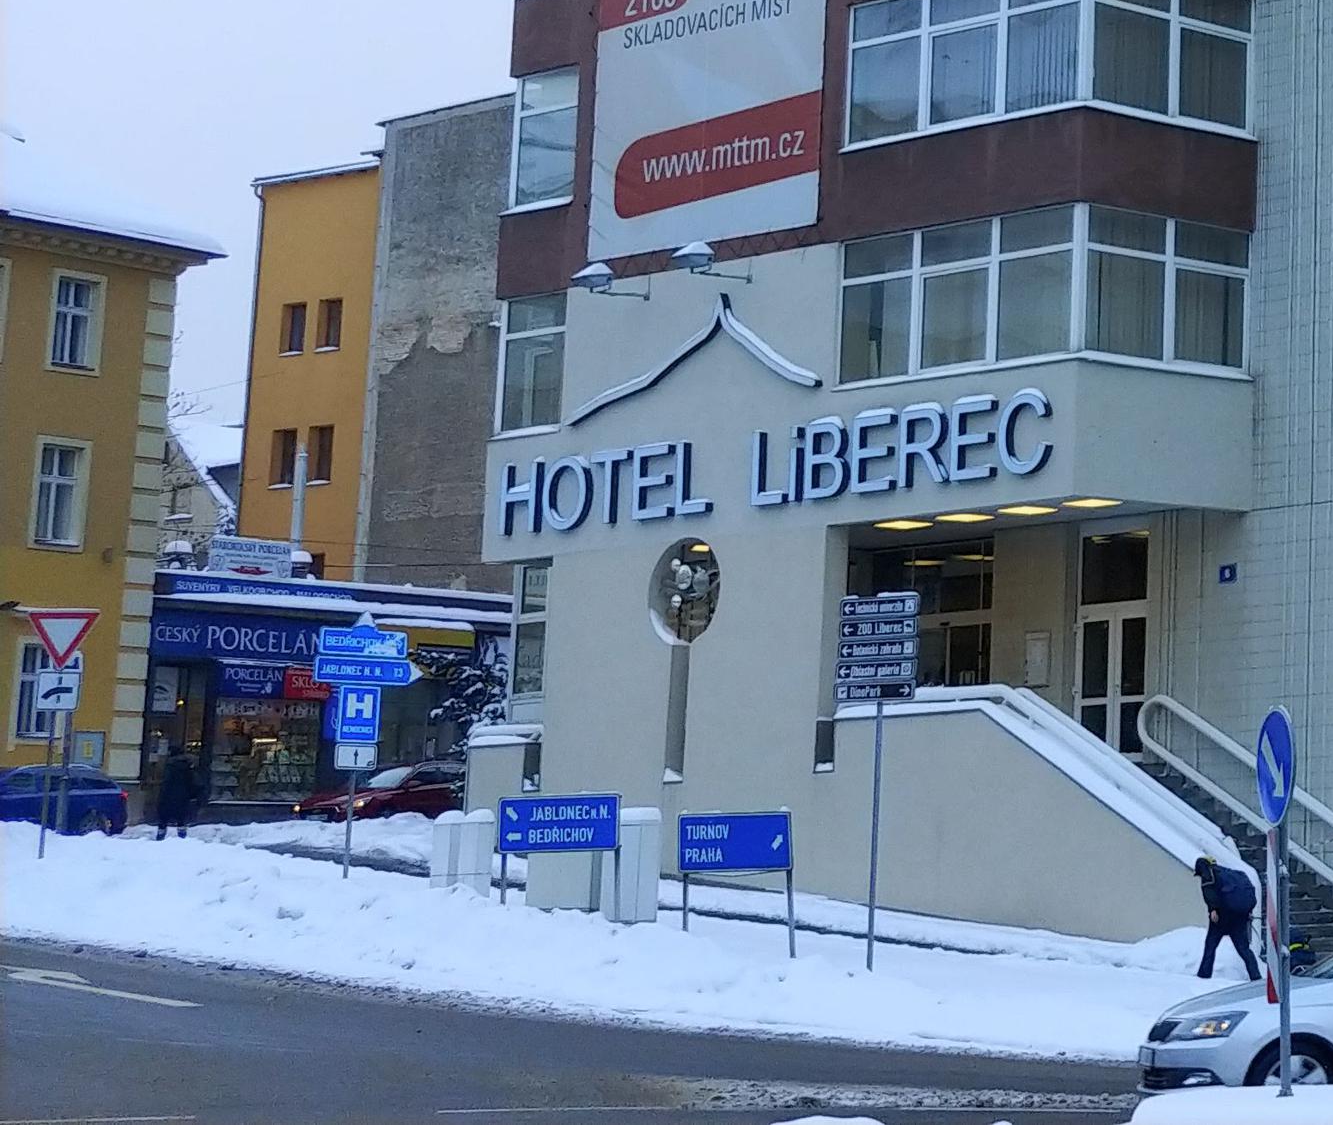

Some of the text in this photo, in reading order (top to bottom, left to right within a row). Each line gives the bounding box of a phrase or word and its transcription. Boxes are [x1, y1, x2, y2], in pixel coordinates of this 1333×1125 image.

[623, 2, 747, 49] SKLADOVACÍCH
[643, 129, 805, 184] www.mttm.cz
[499, 440, 714, 536] HOTEL
[155, 622, 201, 643] ČESKÝ
[857, 621, 902, 635] ZOO Liberec
[225, 666, 283, 682] PORCELÁN
[346, 693, 374, 718] H
[530, 805, 590, 822] JABLONEC
[528, 825, 594, 844] BEDŘICHOV
[686, 824, 730, 841] TURNOV
[685, 847, 723, 863] PRAHA
